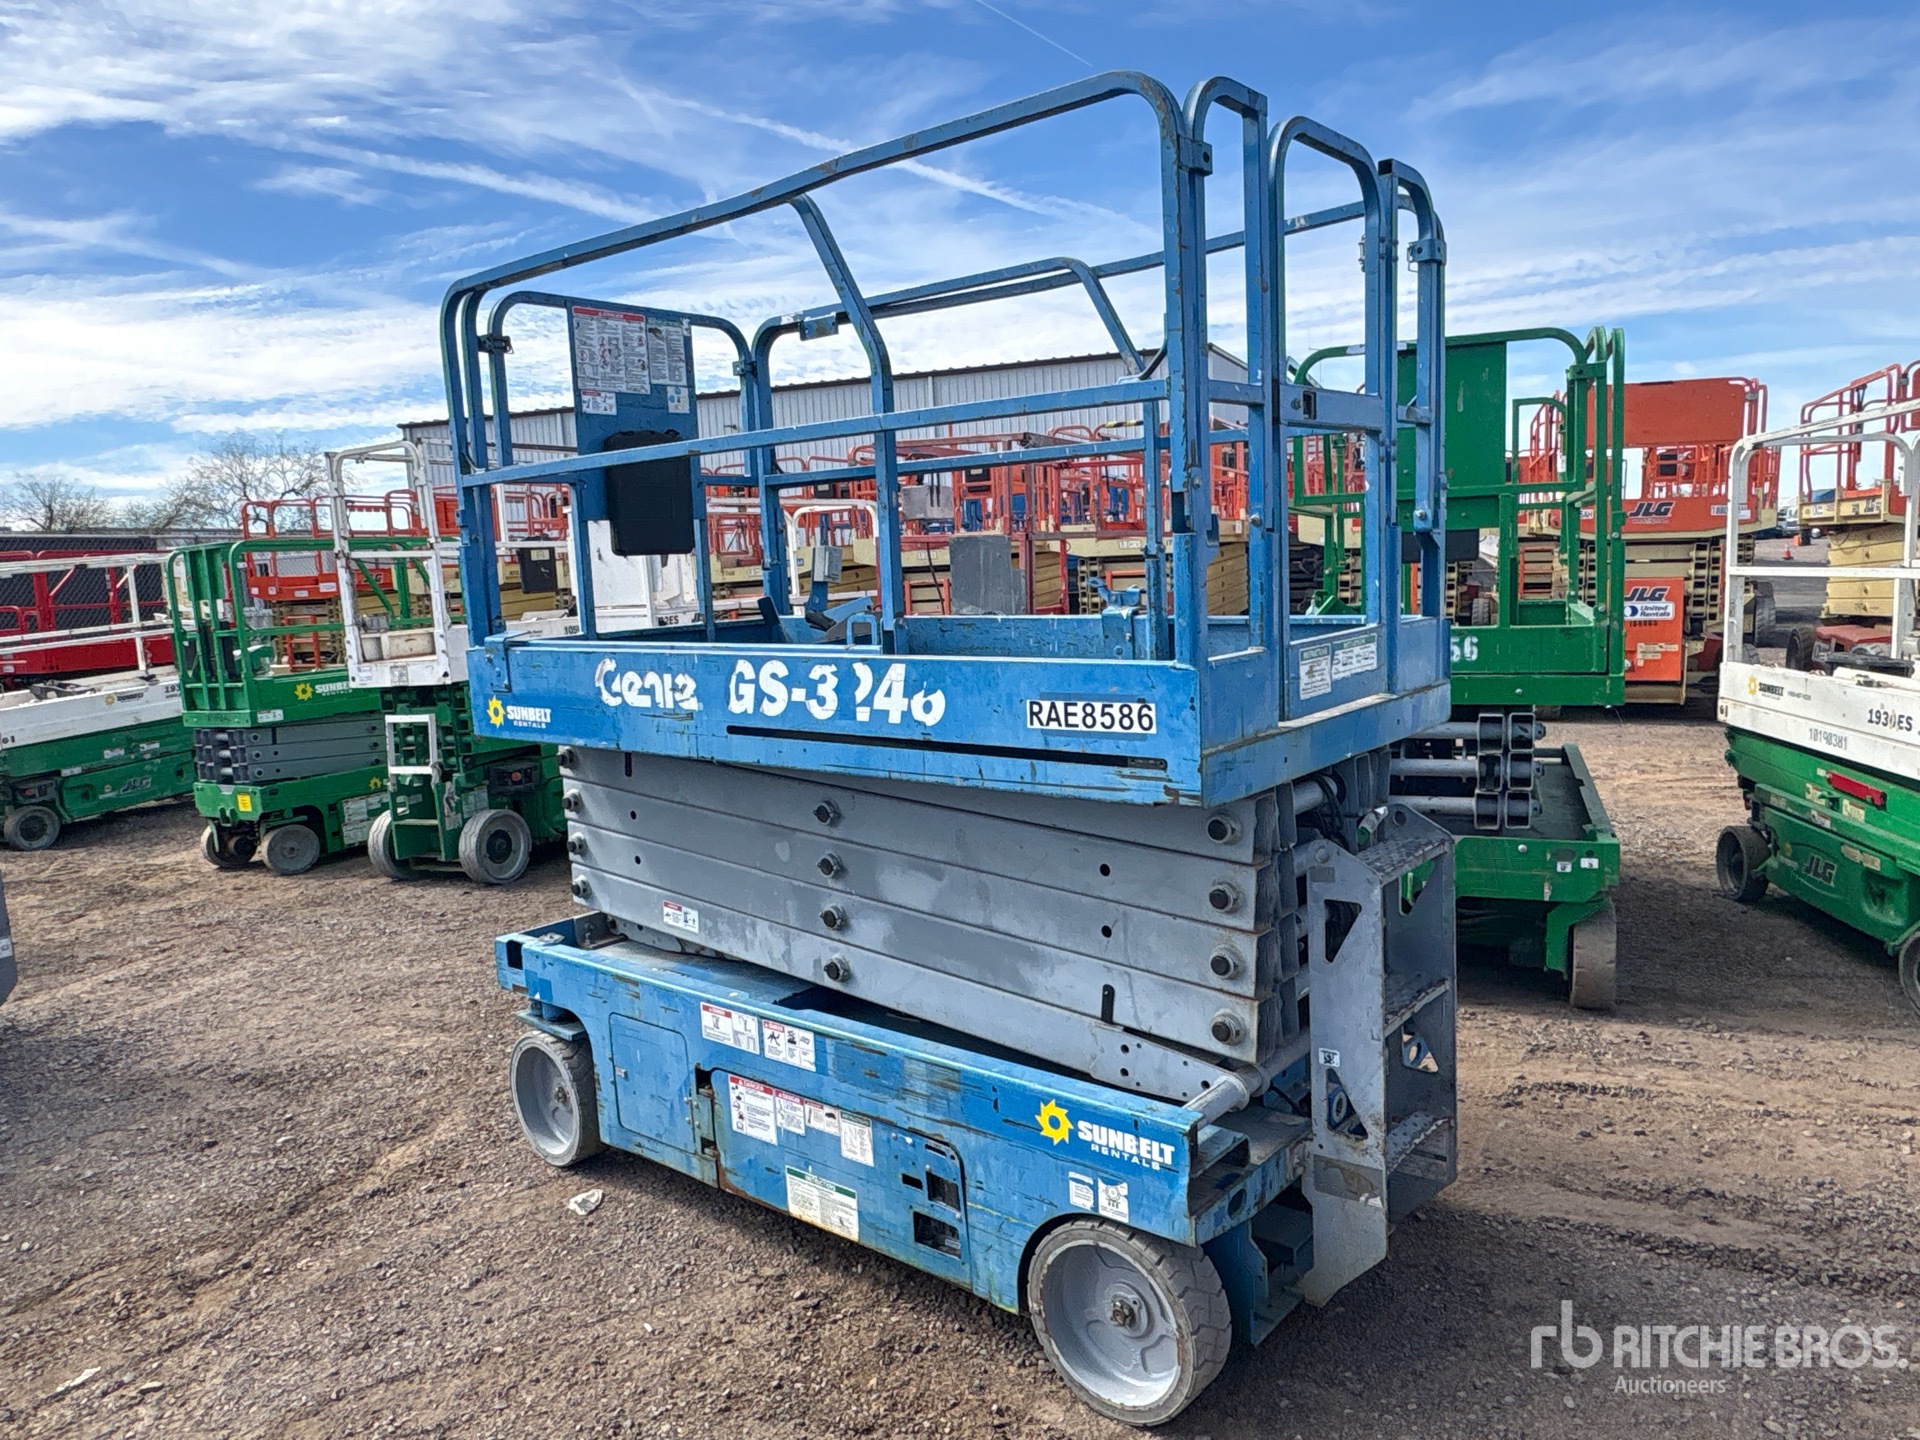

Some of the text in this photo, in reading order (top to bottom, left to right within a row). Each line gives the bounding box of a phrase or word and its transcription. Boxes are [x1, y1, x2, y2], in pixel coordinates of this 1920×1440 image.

[1629, 501, 1675, 517] JLG
[1624, 587, 1669, 602] JLG
[564, 625, 580, 635] 105
[1451, 636, 1478, 662] 56
[506, 705, 551, 723] SUNBELT
[513, 720, 546, 729] RENTALS
[1029, 703, 1154, 732] RAE8586
[1802, 853, 1837, 887] JLG
[1077, 1120, 1175, 1166] SUNBELT
[1091, 1143, 1160, 1171] RENTALS
